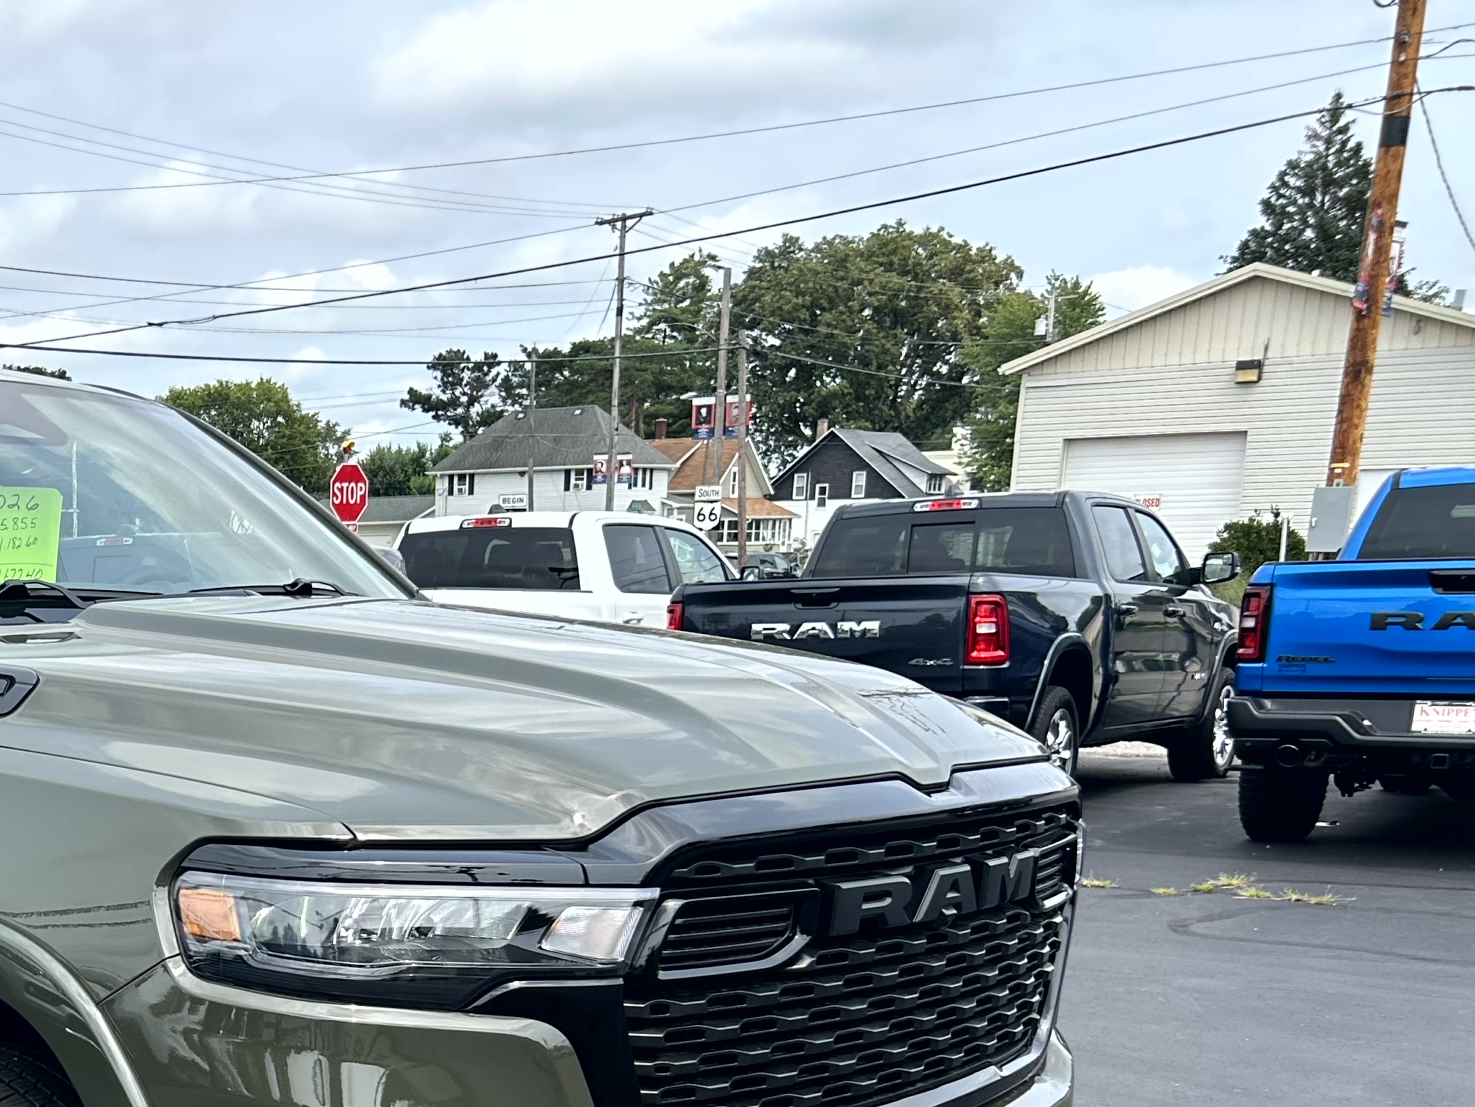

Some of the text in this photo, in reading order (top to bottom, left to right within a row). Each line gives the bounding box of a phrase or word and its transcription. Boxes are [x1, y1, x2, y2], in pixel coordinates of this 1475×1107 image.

[333, 482, 365, 505] STOP
[698, 488, 720, 498] SOUTH
[501, 497, 525, 505] BEGIN
[1136, 498, 1161, 508] OSED
[696, 506, 718, 522] 66
[750, 620, 881, 640] RAM
[1420, 706, 1475, 717] KNIPPE
[829, 850, 1035, 937] RAM
